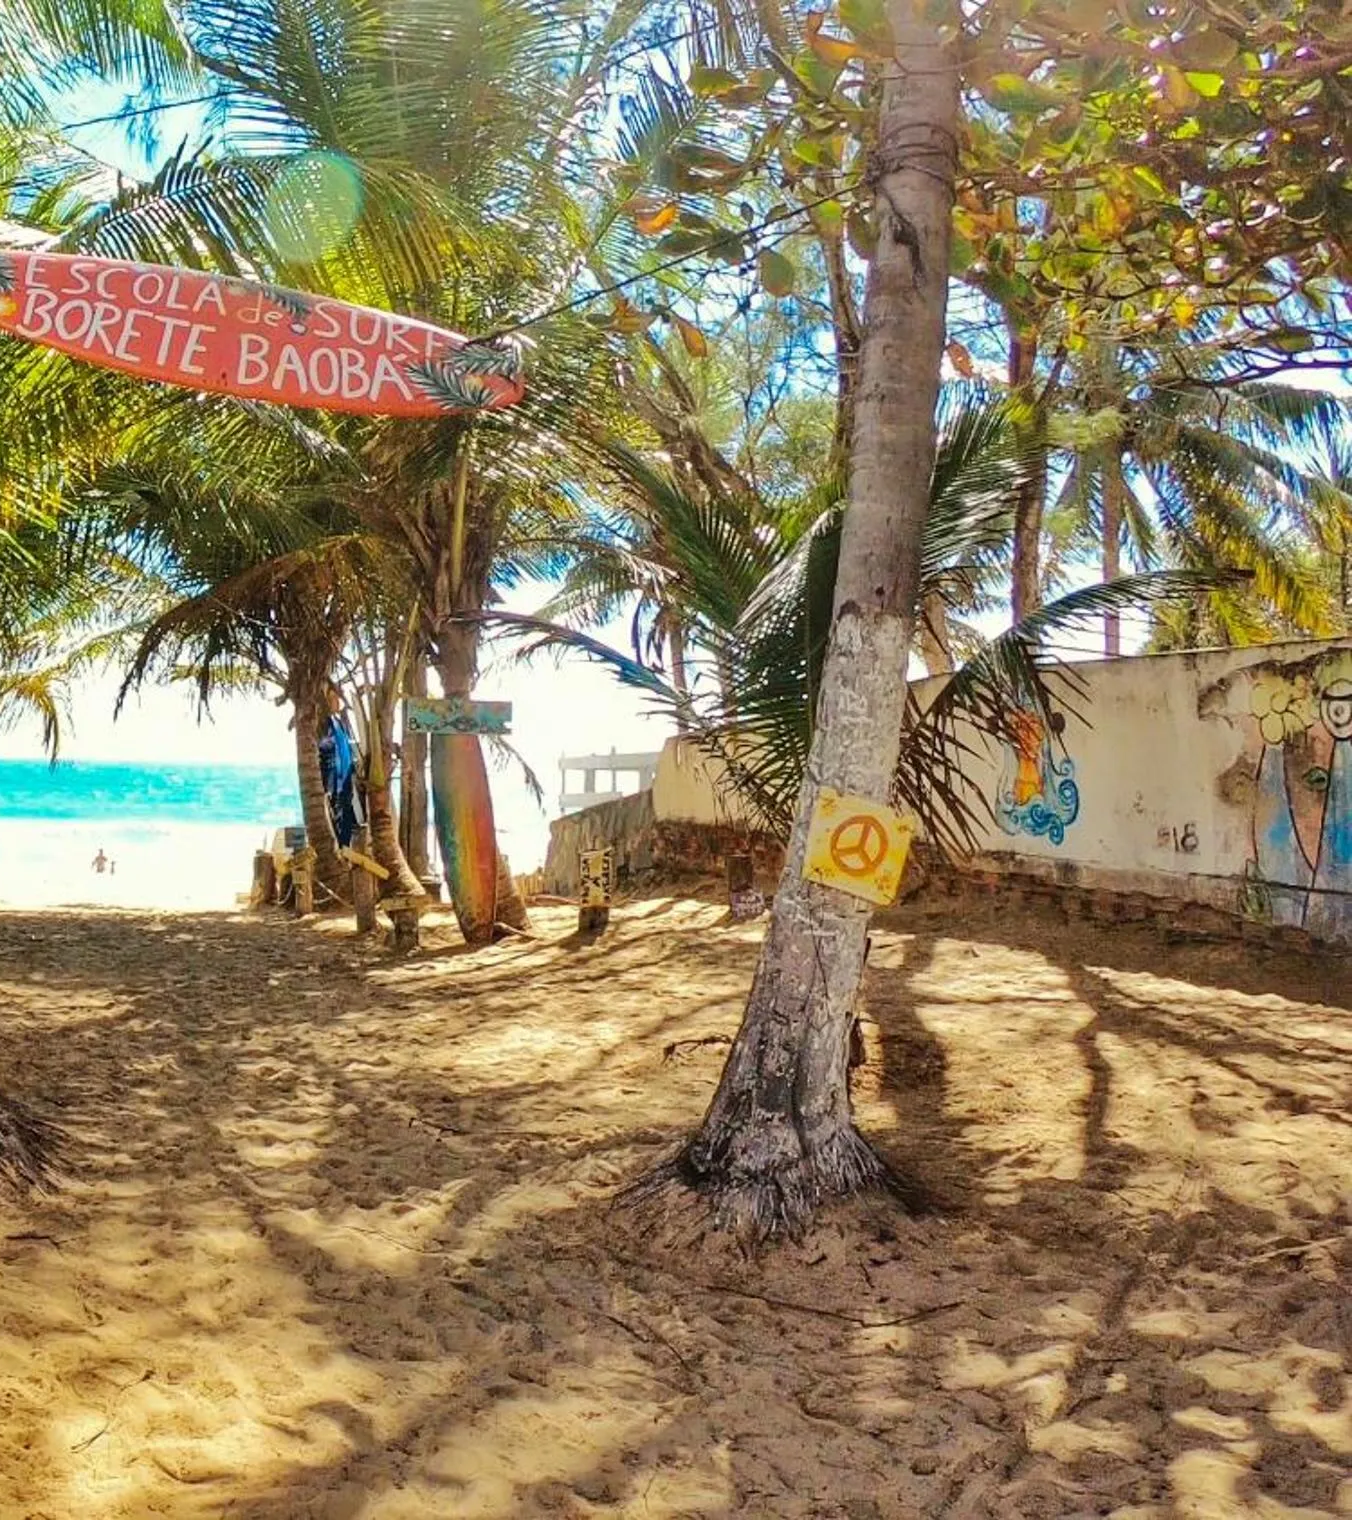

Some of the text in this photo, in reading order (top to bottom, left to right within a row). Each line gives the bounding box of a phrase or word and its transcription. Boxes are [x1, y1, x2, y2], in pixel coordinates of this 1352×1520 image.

[16, 288, 414, 402] BORETE BAOBÁ
[24, 254, 443, 358] ESCOLA de SURF
